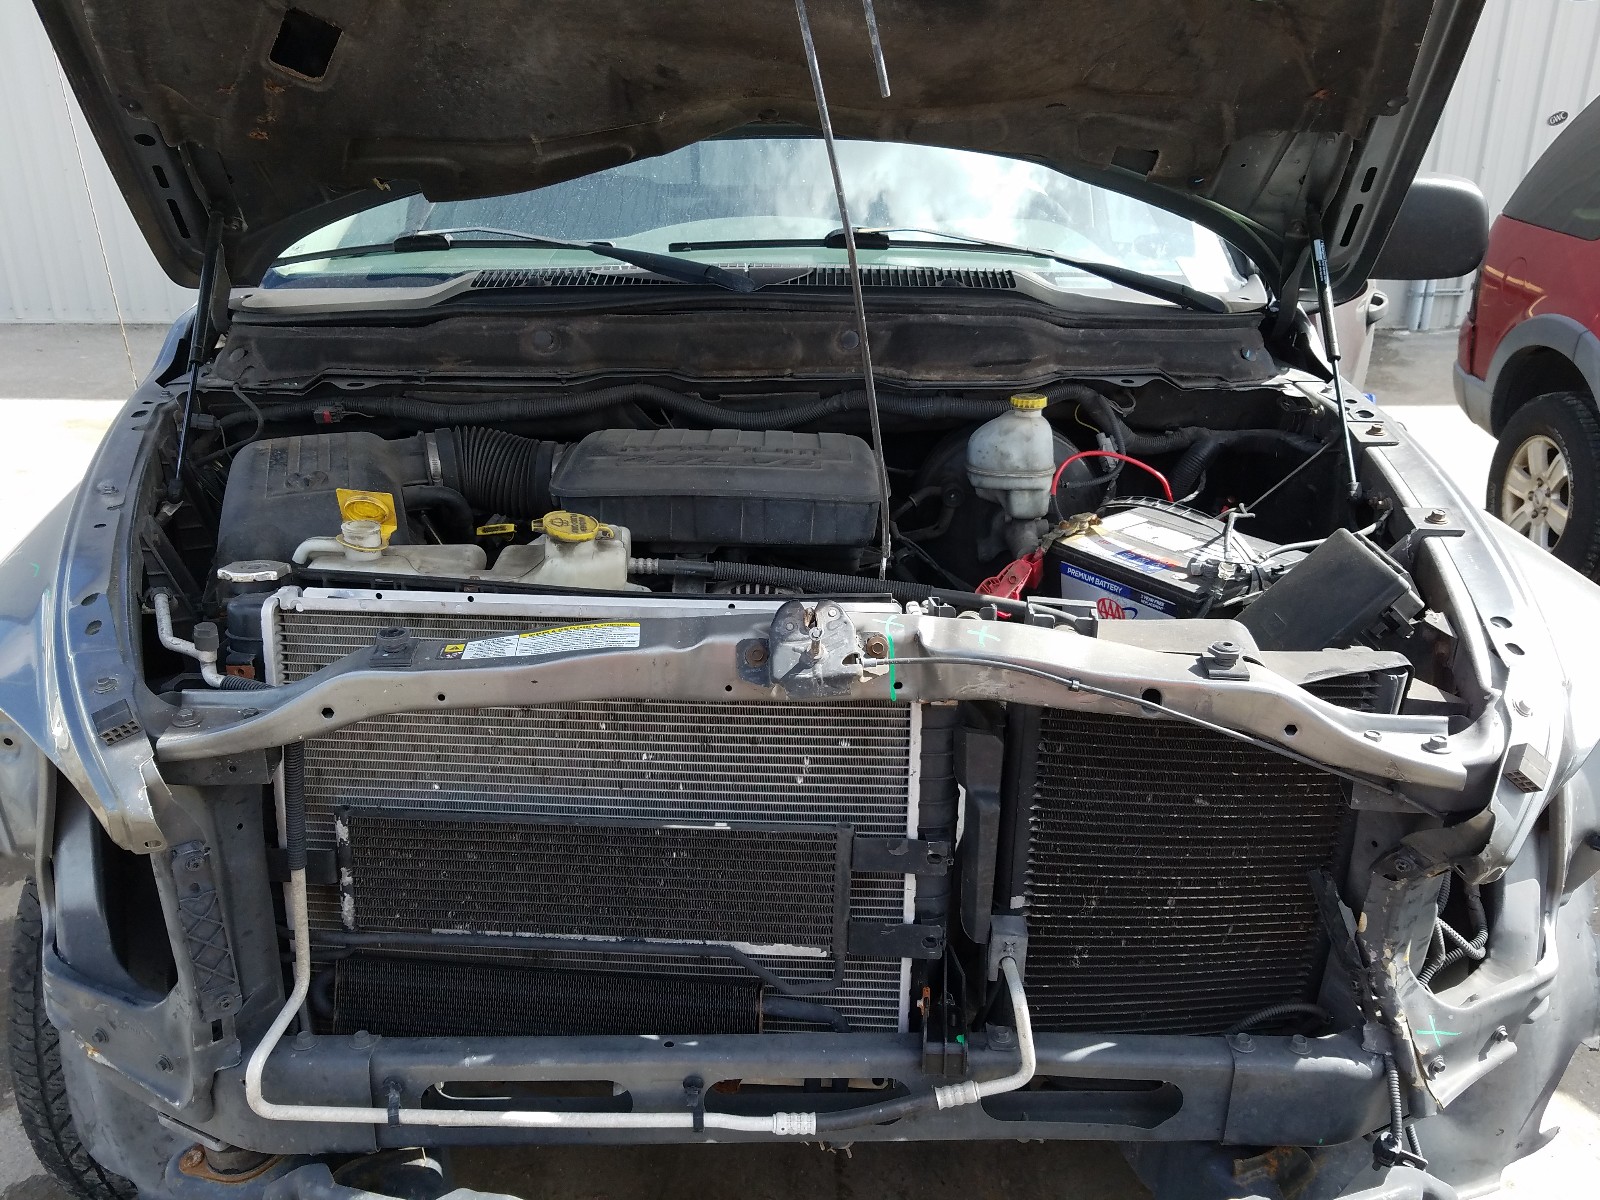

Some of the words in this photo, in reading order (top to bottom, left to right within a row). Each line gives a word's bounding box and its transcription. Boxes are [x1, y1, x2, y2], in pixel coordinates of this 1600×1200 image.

[1067, 567, 1095, 583] PREMIUM
[1094, 577, 1123, 593] BATTERY
[1098, 598, 1125, 619] AAA
